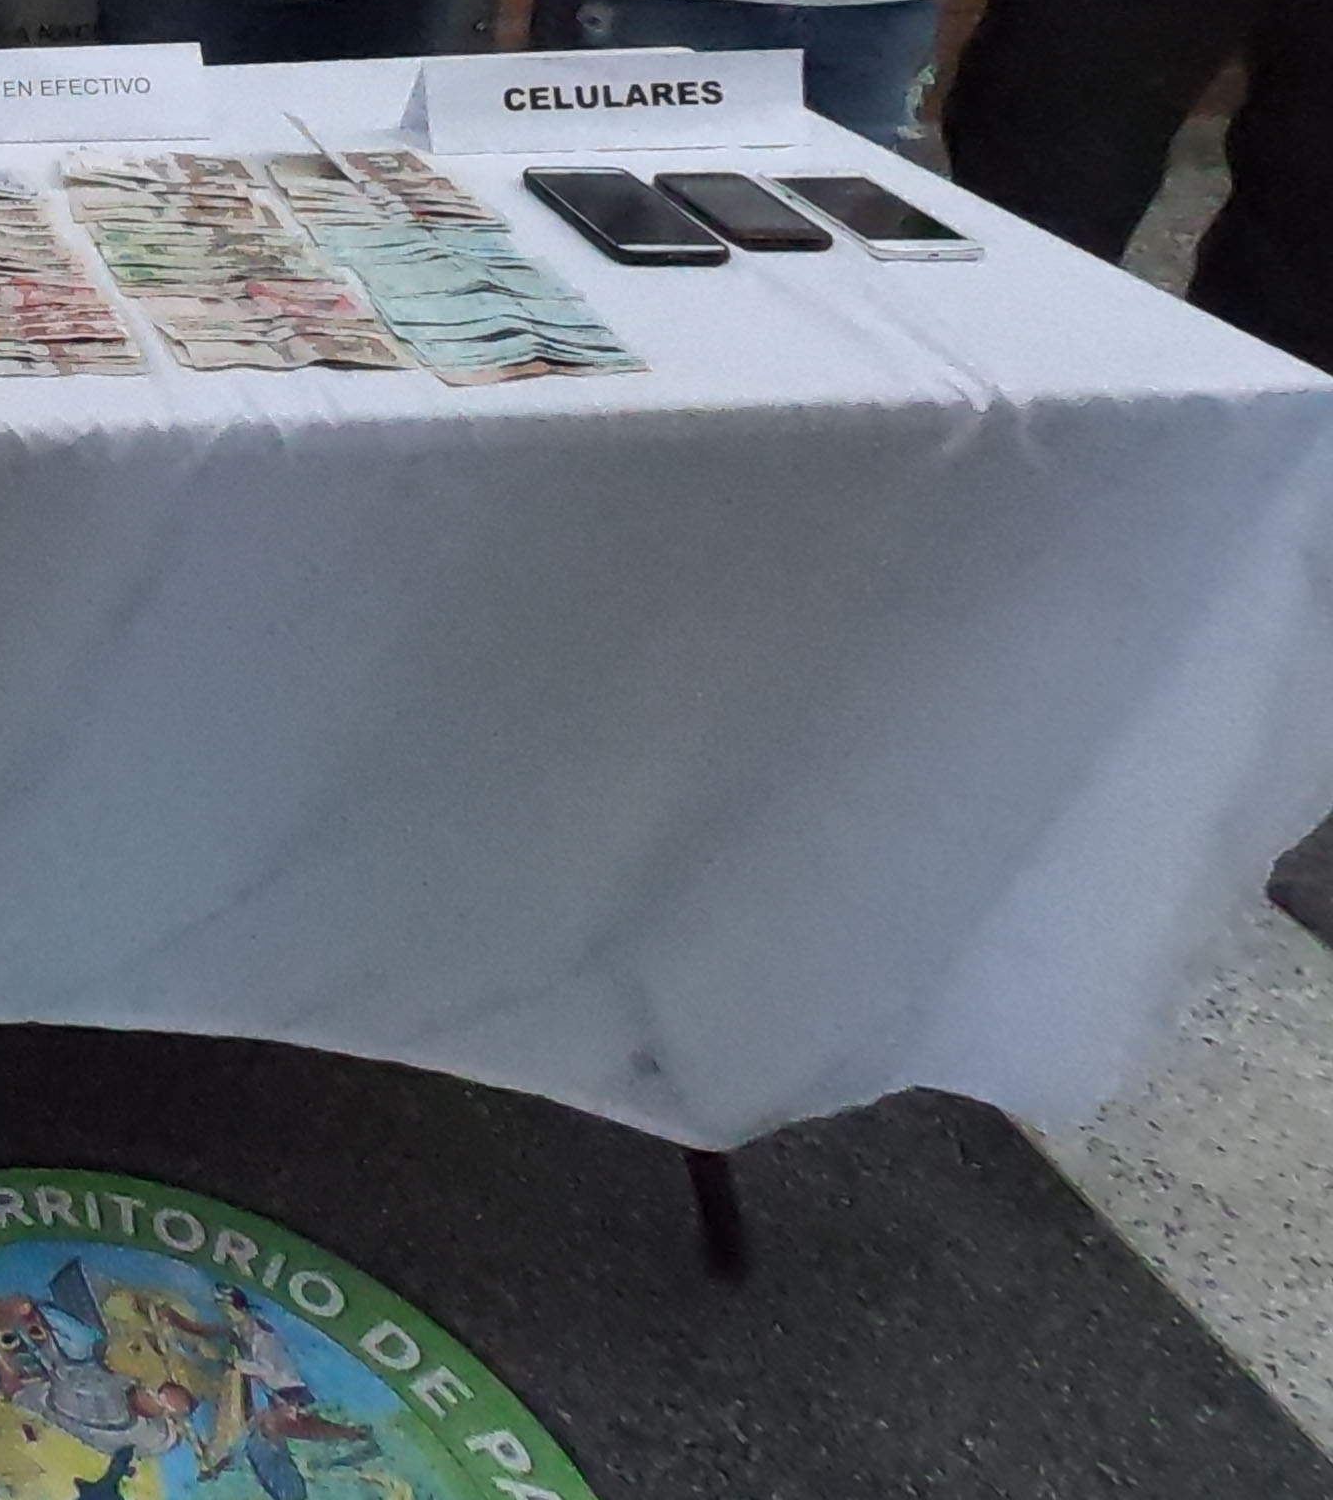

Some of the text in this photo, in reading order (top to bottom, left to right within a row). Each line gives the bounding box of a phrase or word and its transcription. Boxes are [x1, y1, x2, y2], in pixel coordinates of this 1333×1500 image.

[3, 80, 32, 98] EN
[40, 76, 151, 97] EFECTIVO
[503, 80, 723, 111] CELULARES
[359, 1318, 476, 1420] DE
